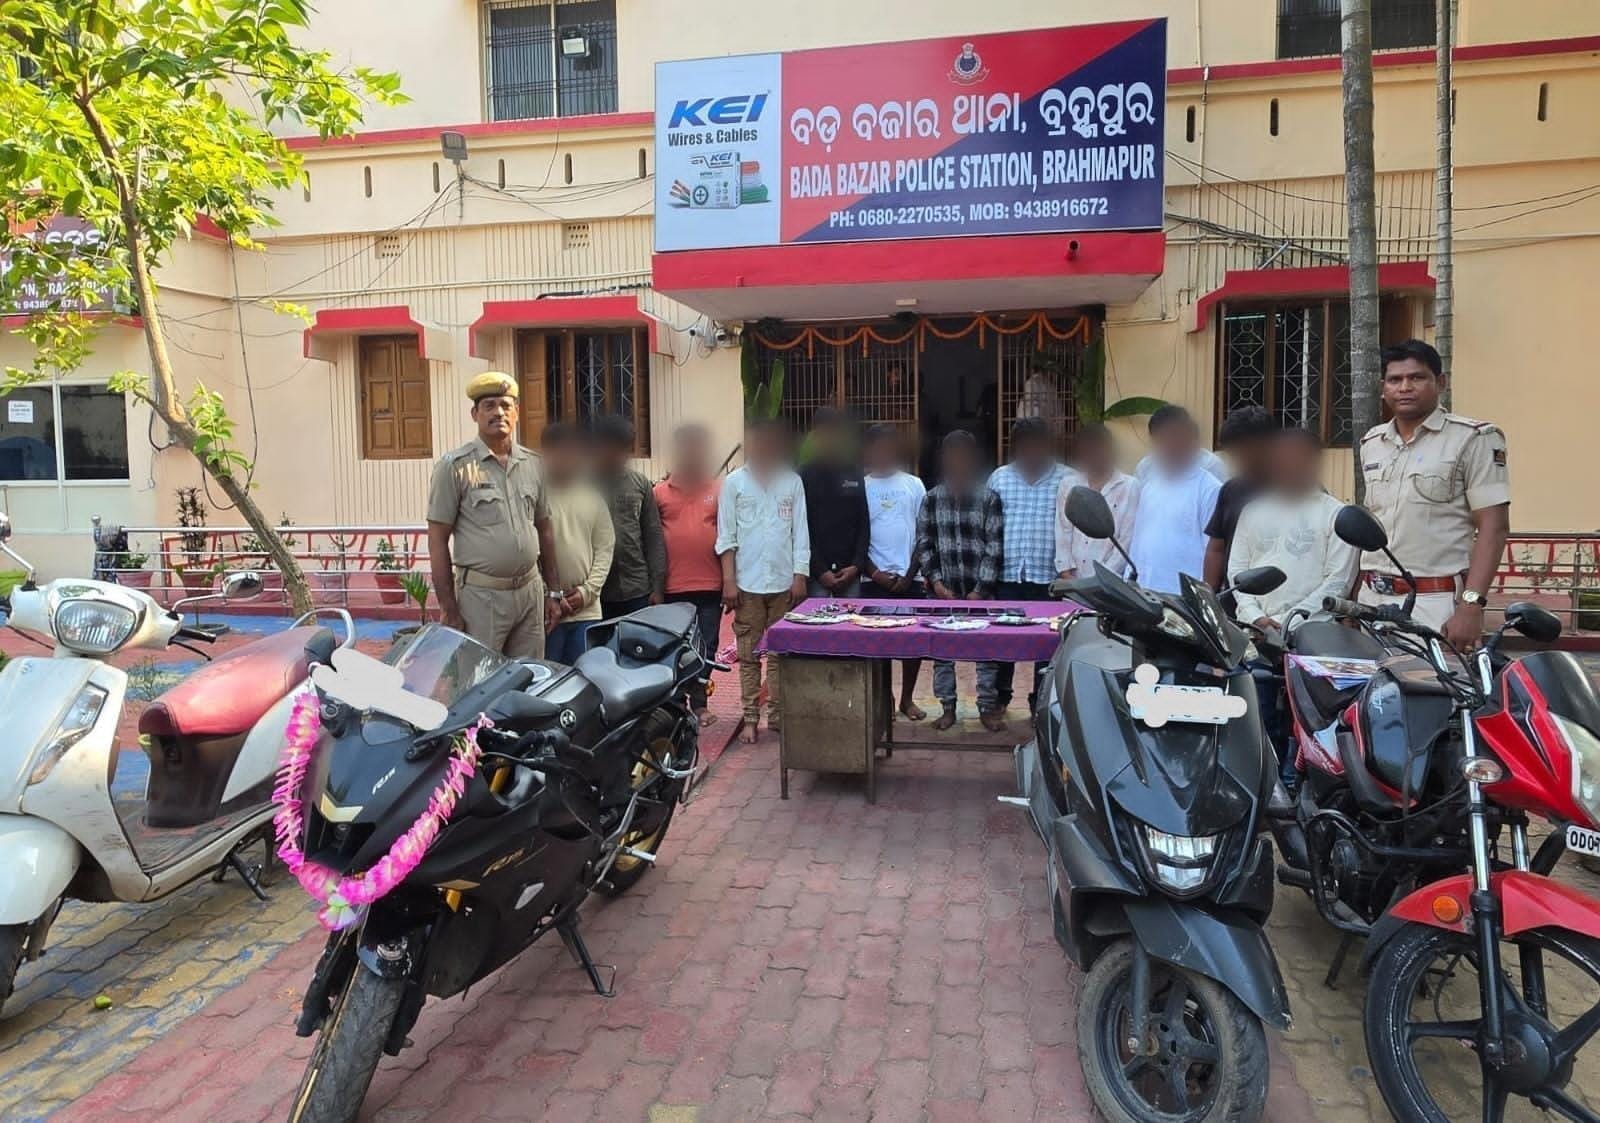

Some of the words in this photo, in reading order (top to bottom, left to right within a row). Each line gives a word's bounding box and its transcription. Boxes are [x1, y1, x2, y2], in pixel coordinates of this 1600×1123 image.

[668, 94, 768, 129] KEI
[790, 105, 841, 153] ବଡ଼
[852, 98, 941, 141] ବଜାର
[952, 92, 1027, 134] ଥାନା,
[1039, 81, 1156, 139] ବ୍ରହ୍ମପୁର
[668, 132, 703, 147] Wires
[705, 132, 713, 145] &
[716, 128, 758, 144] Cables
[790, 164, 833, 199] BADA
[837, 160, 892, 196] BAZAR
[895, 156, 955, 193] POLICE
[959, 151, 1038, 192] STATION,
[1042, 144, 1156, 185] BRAHMAPUR
[830, 211, 855, 228] PH:
[858, 204, 965, 226] 0680-2270535,
[969, 203, 1009, 221] MOB:
[1013, 197, 1109, 219] 9438916672
